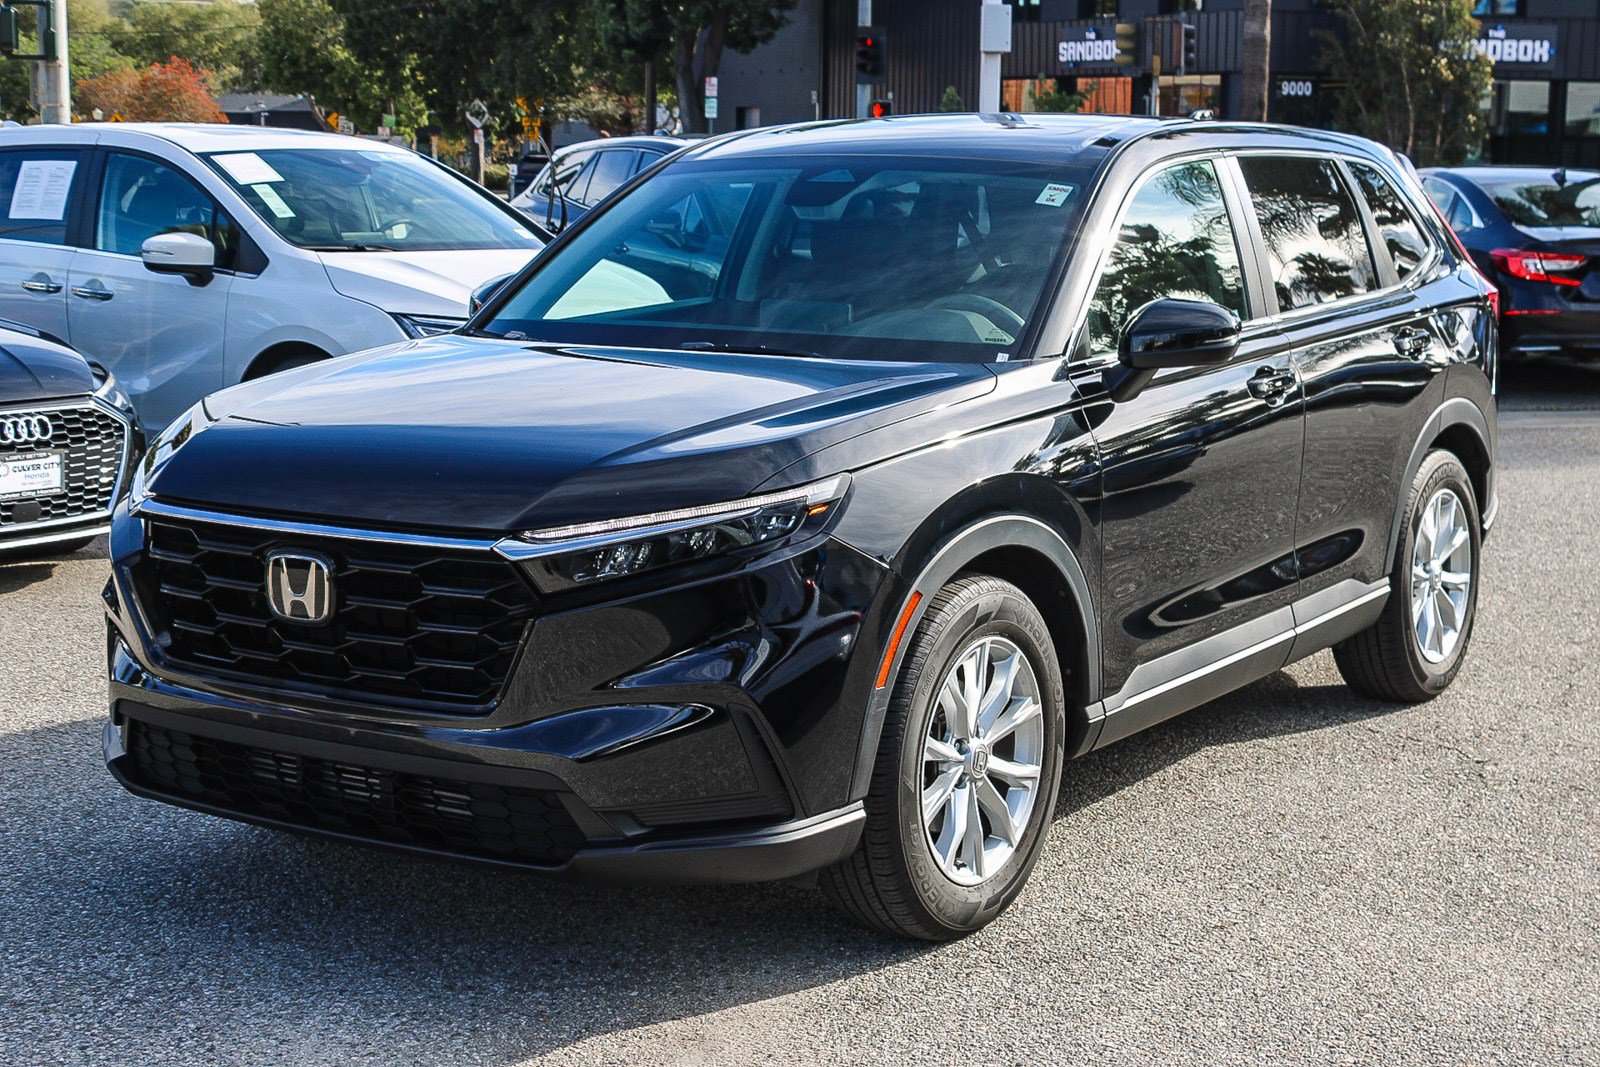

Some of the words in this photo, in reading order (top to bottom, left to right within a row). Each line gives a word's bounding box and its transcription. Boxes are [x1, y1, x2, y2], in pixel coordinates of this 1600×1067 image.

[1439, 39, 1550, 62] NDBOX
[1281, 80, 1312, 96] 9000
[12, 463, 41, 473] CULVER
[43, 462, 61, 470] CITY
